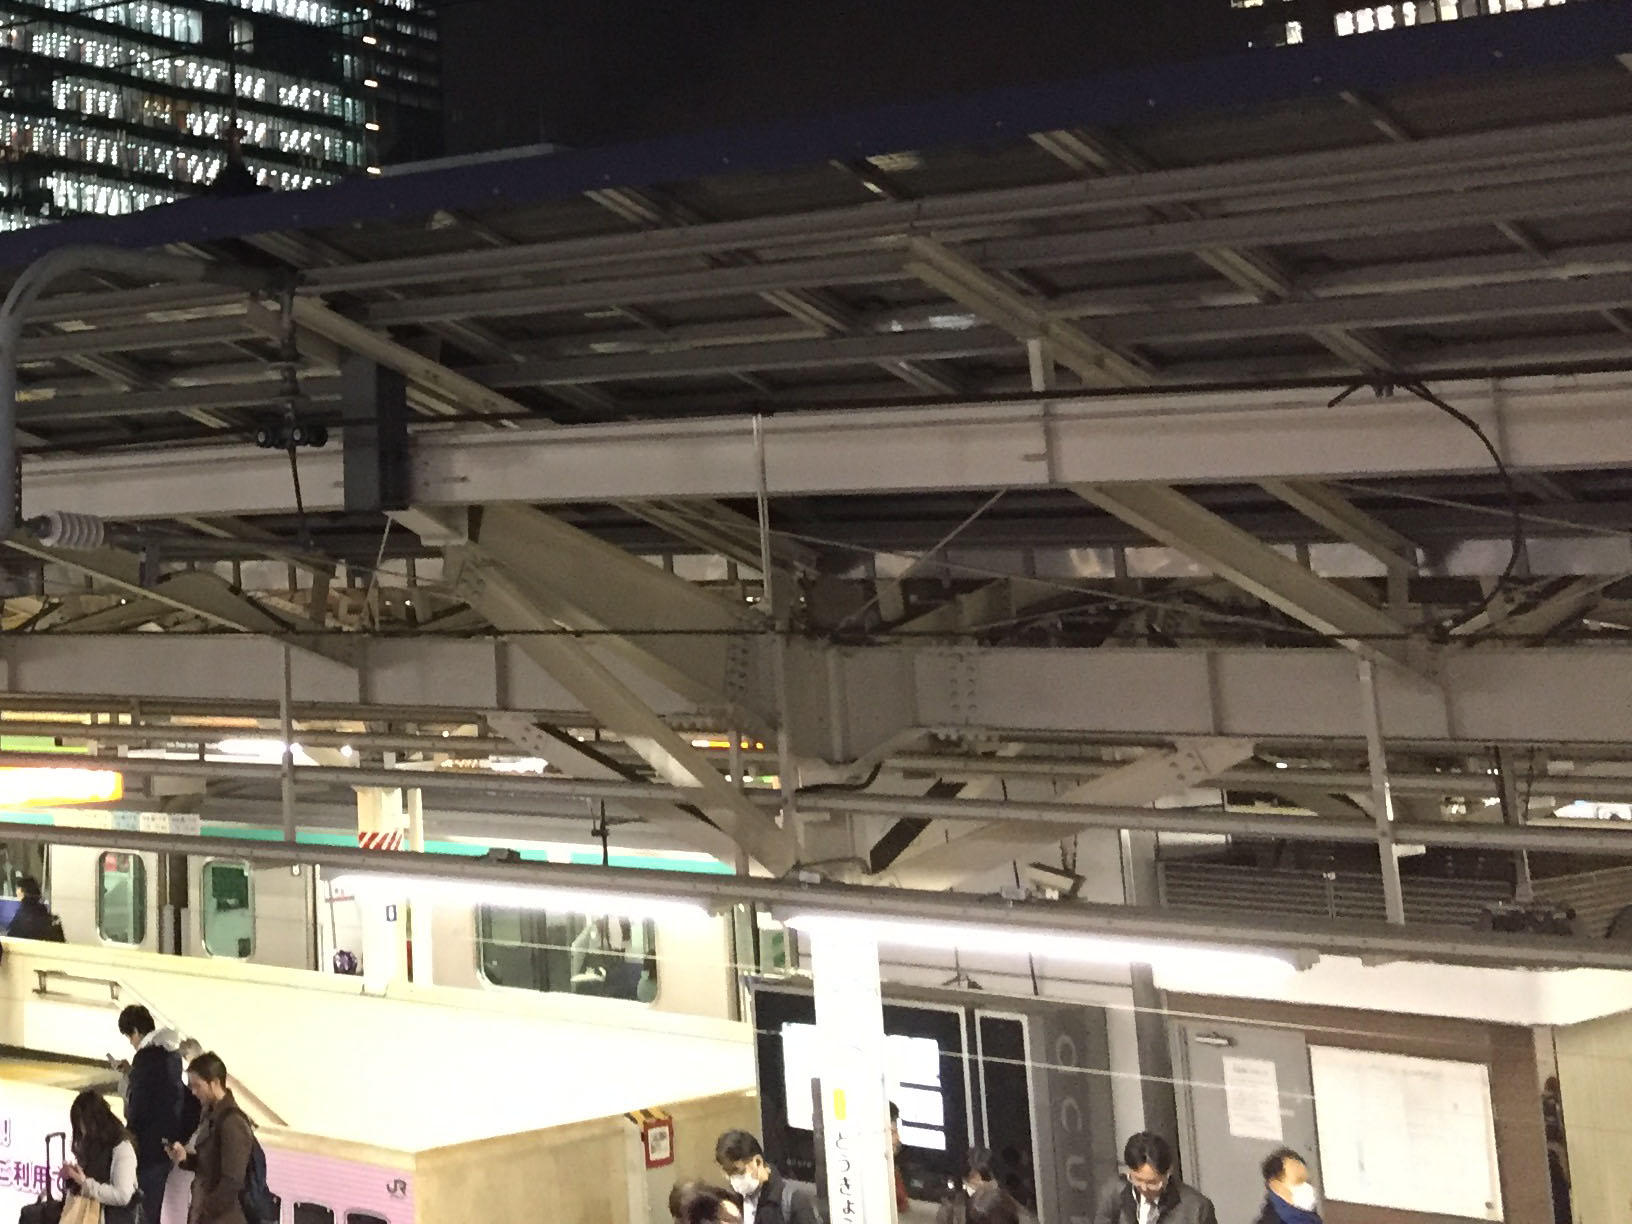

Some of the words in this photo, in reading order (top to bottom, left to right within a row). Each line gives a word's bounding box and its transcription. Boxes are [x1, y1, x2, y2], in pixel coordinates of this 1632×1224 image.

[386, 1179, 406, 1196] JR
[834, 1131, 856, 1224] とうきょ
